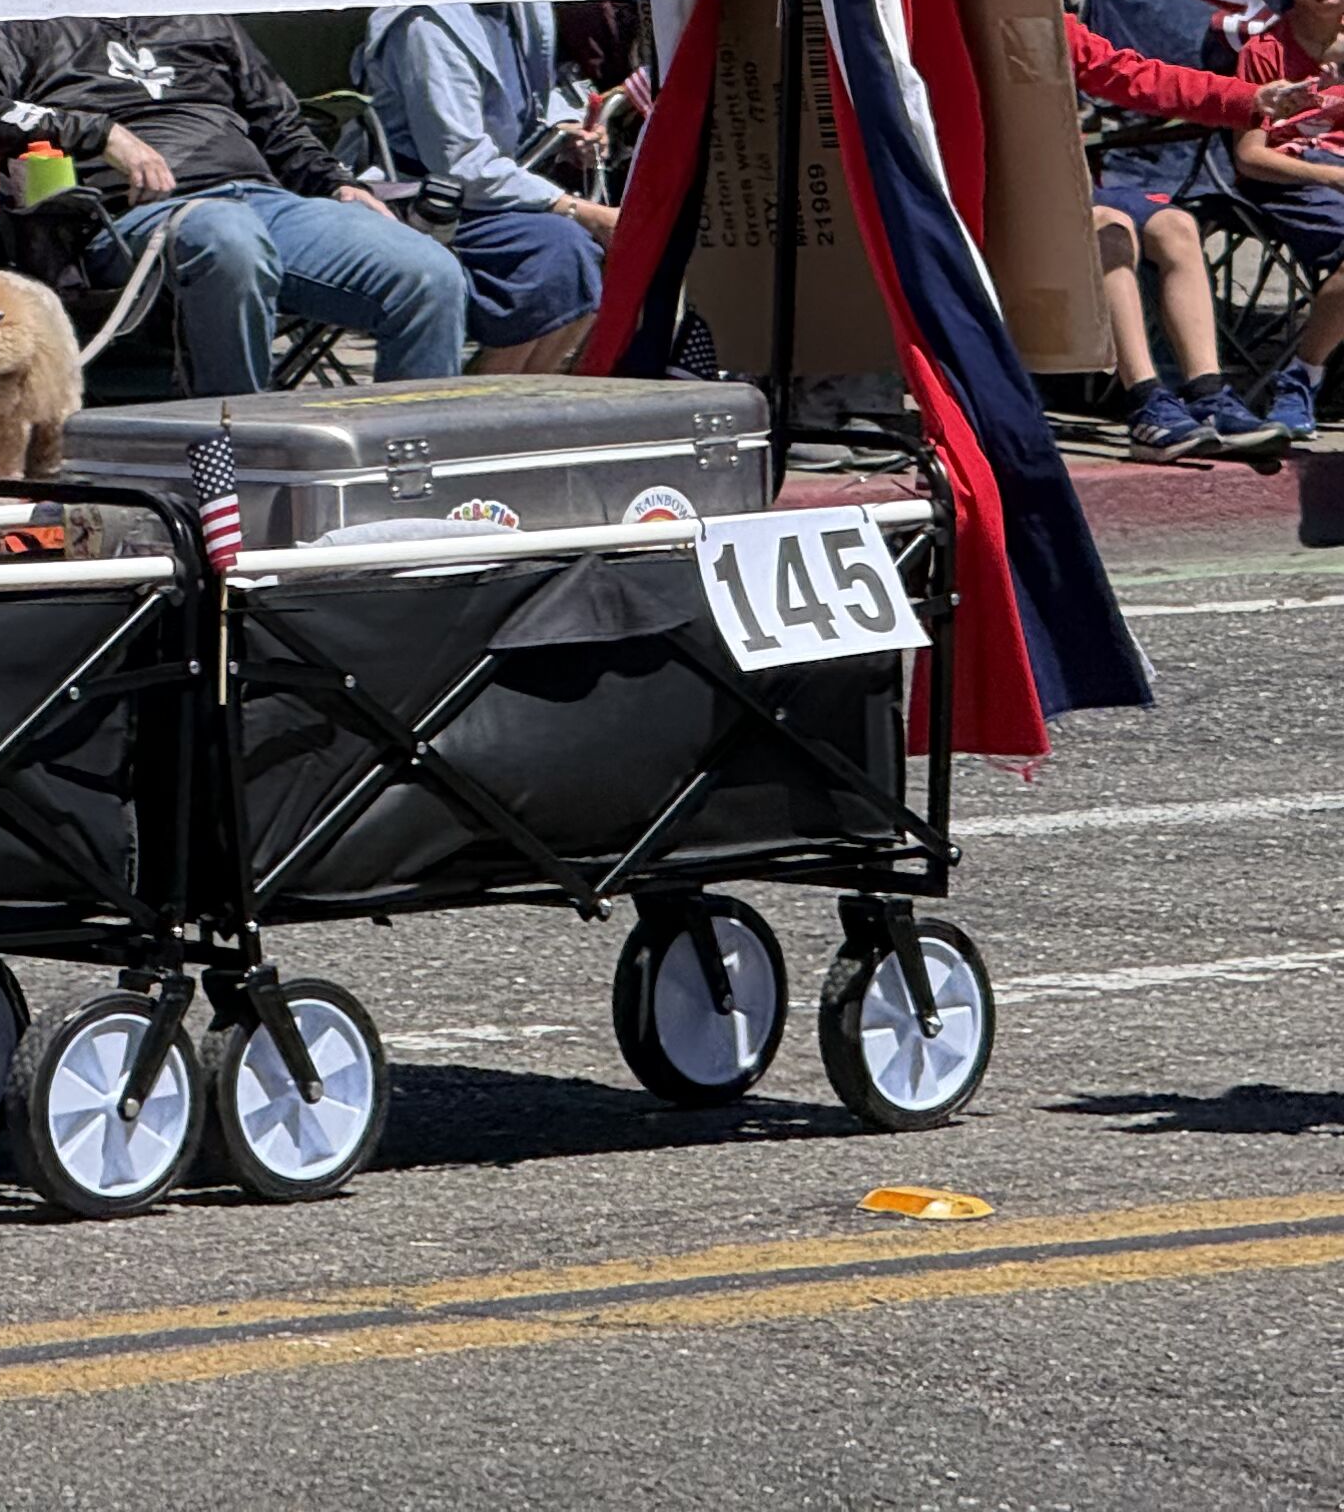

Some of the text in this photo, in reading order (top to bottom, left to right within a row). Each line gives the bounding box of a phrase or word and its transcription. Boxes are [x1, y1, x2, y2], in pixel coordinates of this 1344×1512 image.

[805, 163, 834, 247] 21969
[634, 494, 690, 520] RAINBOW
[712, 528, 896, 653] 145
